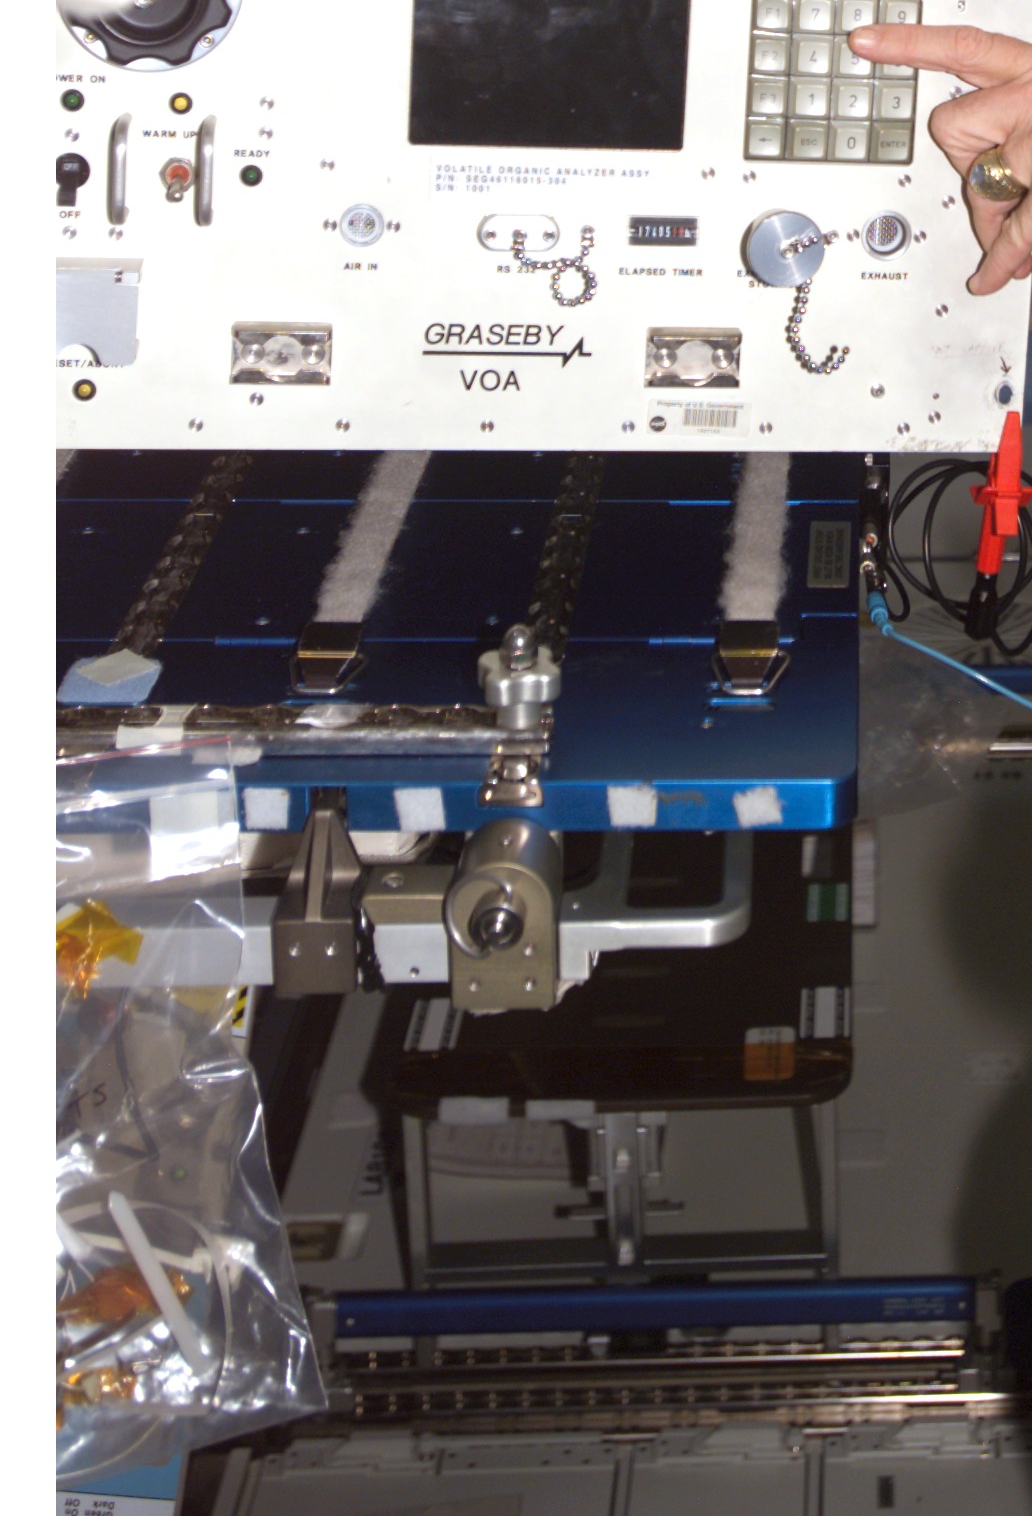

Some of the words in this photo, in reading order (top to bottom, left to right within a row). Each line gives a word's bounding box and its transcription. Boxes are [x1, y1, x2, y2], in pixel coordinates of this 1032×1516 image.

[765, 7, 781, 18] F1
[811, 7, 820, 20] 7
[853, 8, 862, 22] 8
[897, 10, 907, 24] 9
[761, 51, 778, 63] F2
[809, 51, 818, 63] 4
[851, 54, 860, 66] 5
[56, 74, 83, 83] WER
[89, 74, 106, 84] ON
[759, 92, 777, 105] F3
[808, 93, 815, 106] 1
[848, 94, 858, 108] 2
[892, 96, 901, 110] 3
[142, 129, 177, 138] WARM
[183, 130, 197, 139] UP
[800, 138, 818, 147] ESC
[847, 136, 856, 150] 0
[880, 140, 907, 150] ENTER
[233, 149, 270, 158] READY
[435, 164, 493, 174] VOLATILE
[498, 165, 551, 175] ORGANIC
[556, 167, 616, 177] ANALYZER
[466, 184, 491, 193] 1001
[58, 210, 81, 219] OFF
[343, 262, 362, 271] AIR
[367, 262, 378, 271] IN
[496, 265, 511, 274] RS
[516, 265, 536, 274] 232
[618, 267, 666, 276] ELAPSED
[672, 268, 703, 277] TIMER
[860, 271, 909, 281] EXHAUST
[424, 322, 565, 346] GRASEBY
[459, 369, 521, 392] VOA
[65, 1499, 80, 1507] Off
[93, 1501, 115, 1510] Dark
